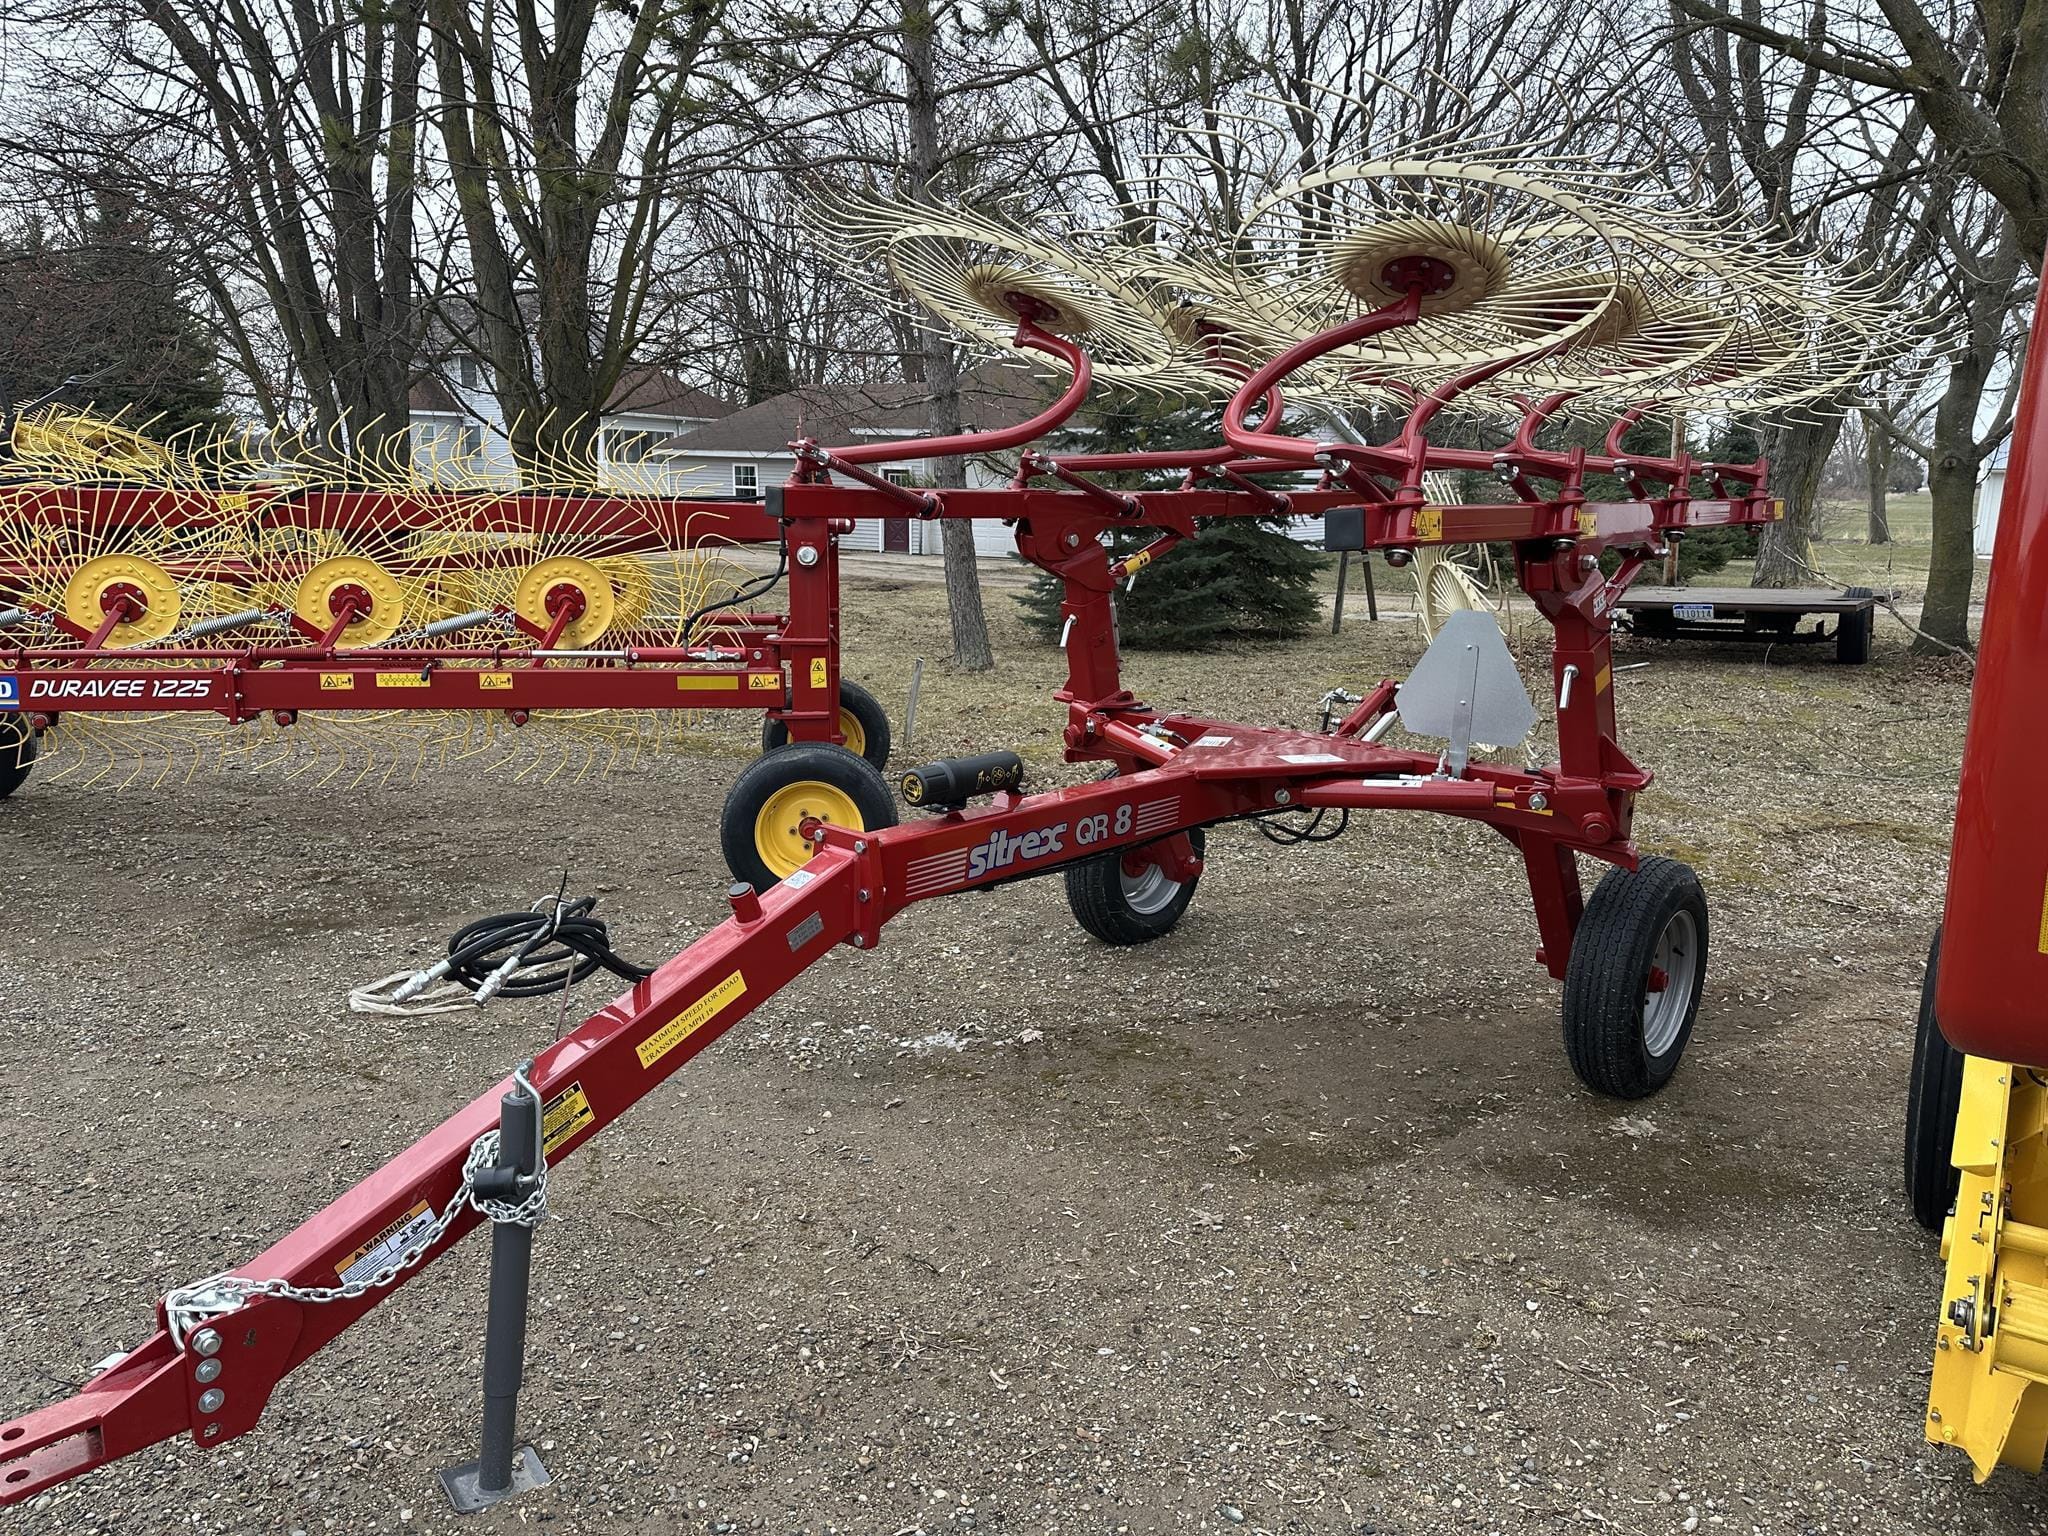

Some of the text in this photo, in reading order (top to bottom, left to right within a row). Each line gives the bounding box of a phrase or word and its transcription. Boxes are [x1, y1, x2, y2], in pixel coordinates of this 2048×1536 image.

[30, 679, 213, 698] DURAVEE 1225
[967, 804, 1133, 880] sitrex QR 8
[640, 975, 739, 1054] MAXIMUM SPEED FOR ROAD
[644, 1007, 714, 1063] TRANSPORT MPH 19
[363, 1212, 413, 1252] WARNING
